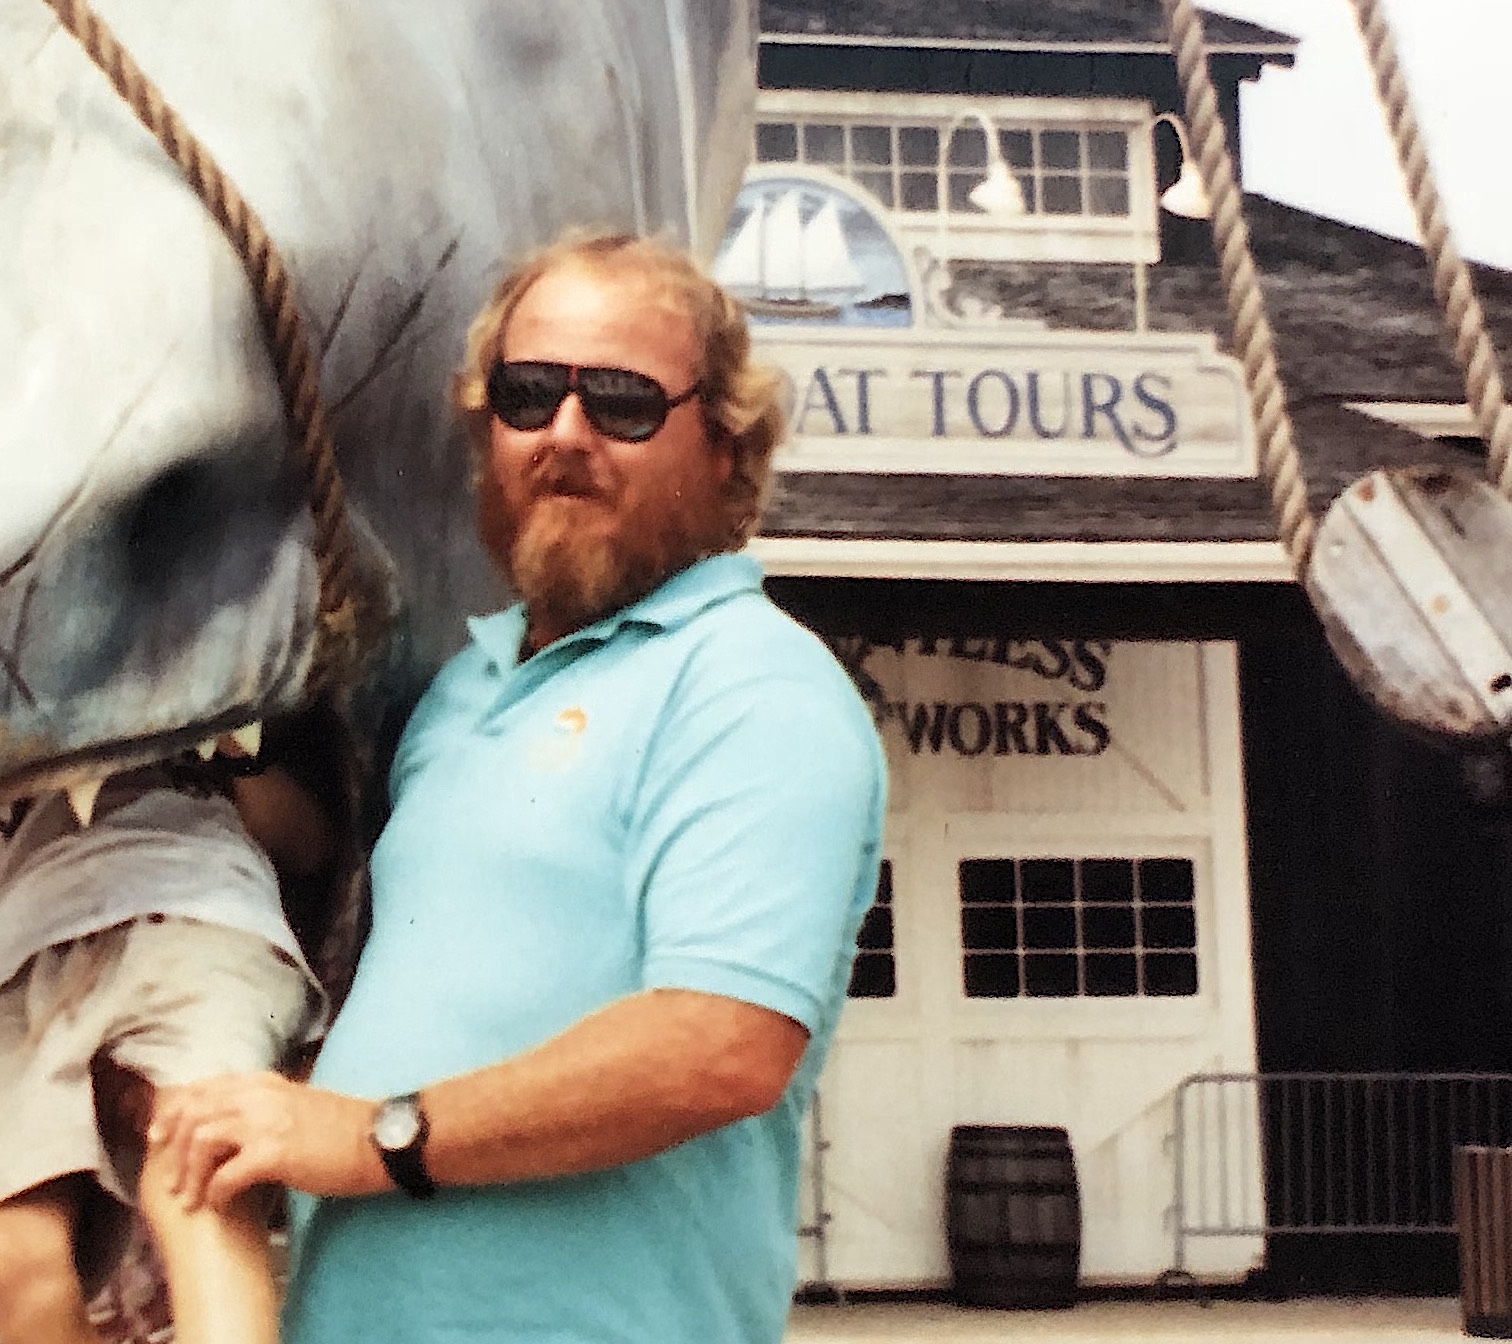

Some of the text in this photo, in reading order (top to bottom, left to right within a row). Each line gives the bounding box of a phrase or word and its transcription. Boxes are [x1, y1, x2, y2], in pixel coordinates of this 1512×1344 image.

[784, 366, 1178, 457] AT TOURS
[890, 701, 1110, 757] WORKS
